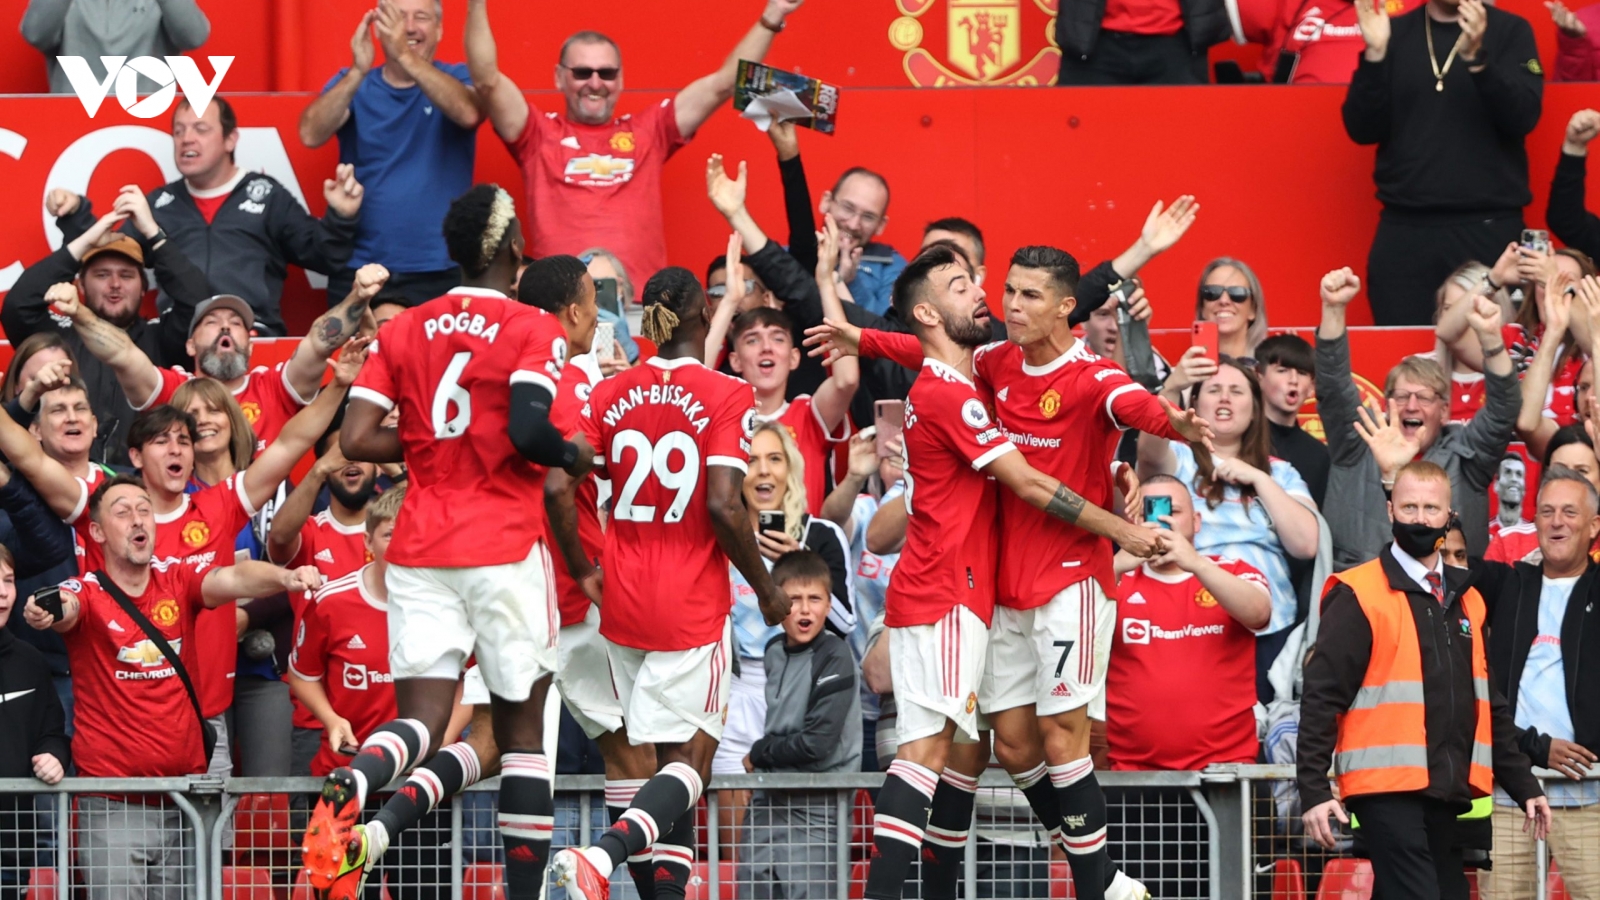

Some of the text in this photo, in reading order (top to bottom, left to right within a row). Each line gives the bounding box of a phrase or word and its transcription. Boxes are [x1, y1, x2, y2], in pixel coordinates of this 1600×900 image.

[424, 311, 500, 344] POGBA
[431, 351, 472, 439] 6
[603, 384, 710, 434] WAN-BISSAKA
[1001, 427, 1062, 448] TeamViewer
[611, 428, 700, 523] 29
[1150, 623, 1225, 640] TeamViewer
[1052, 640, 1076, 678] 7
